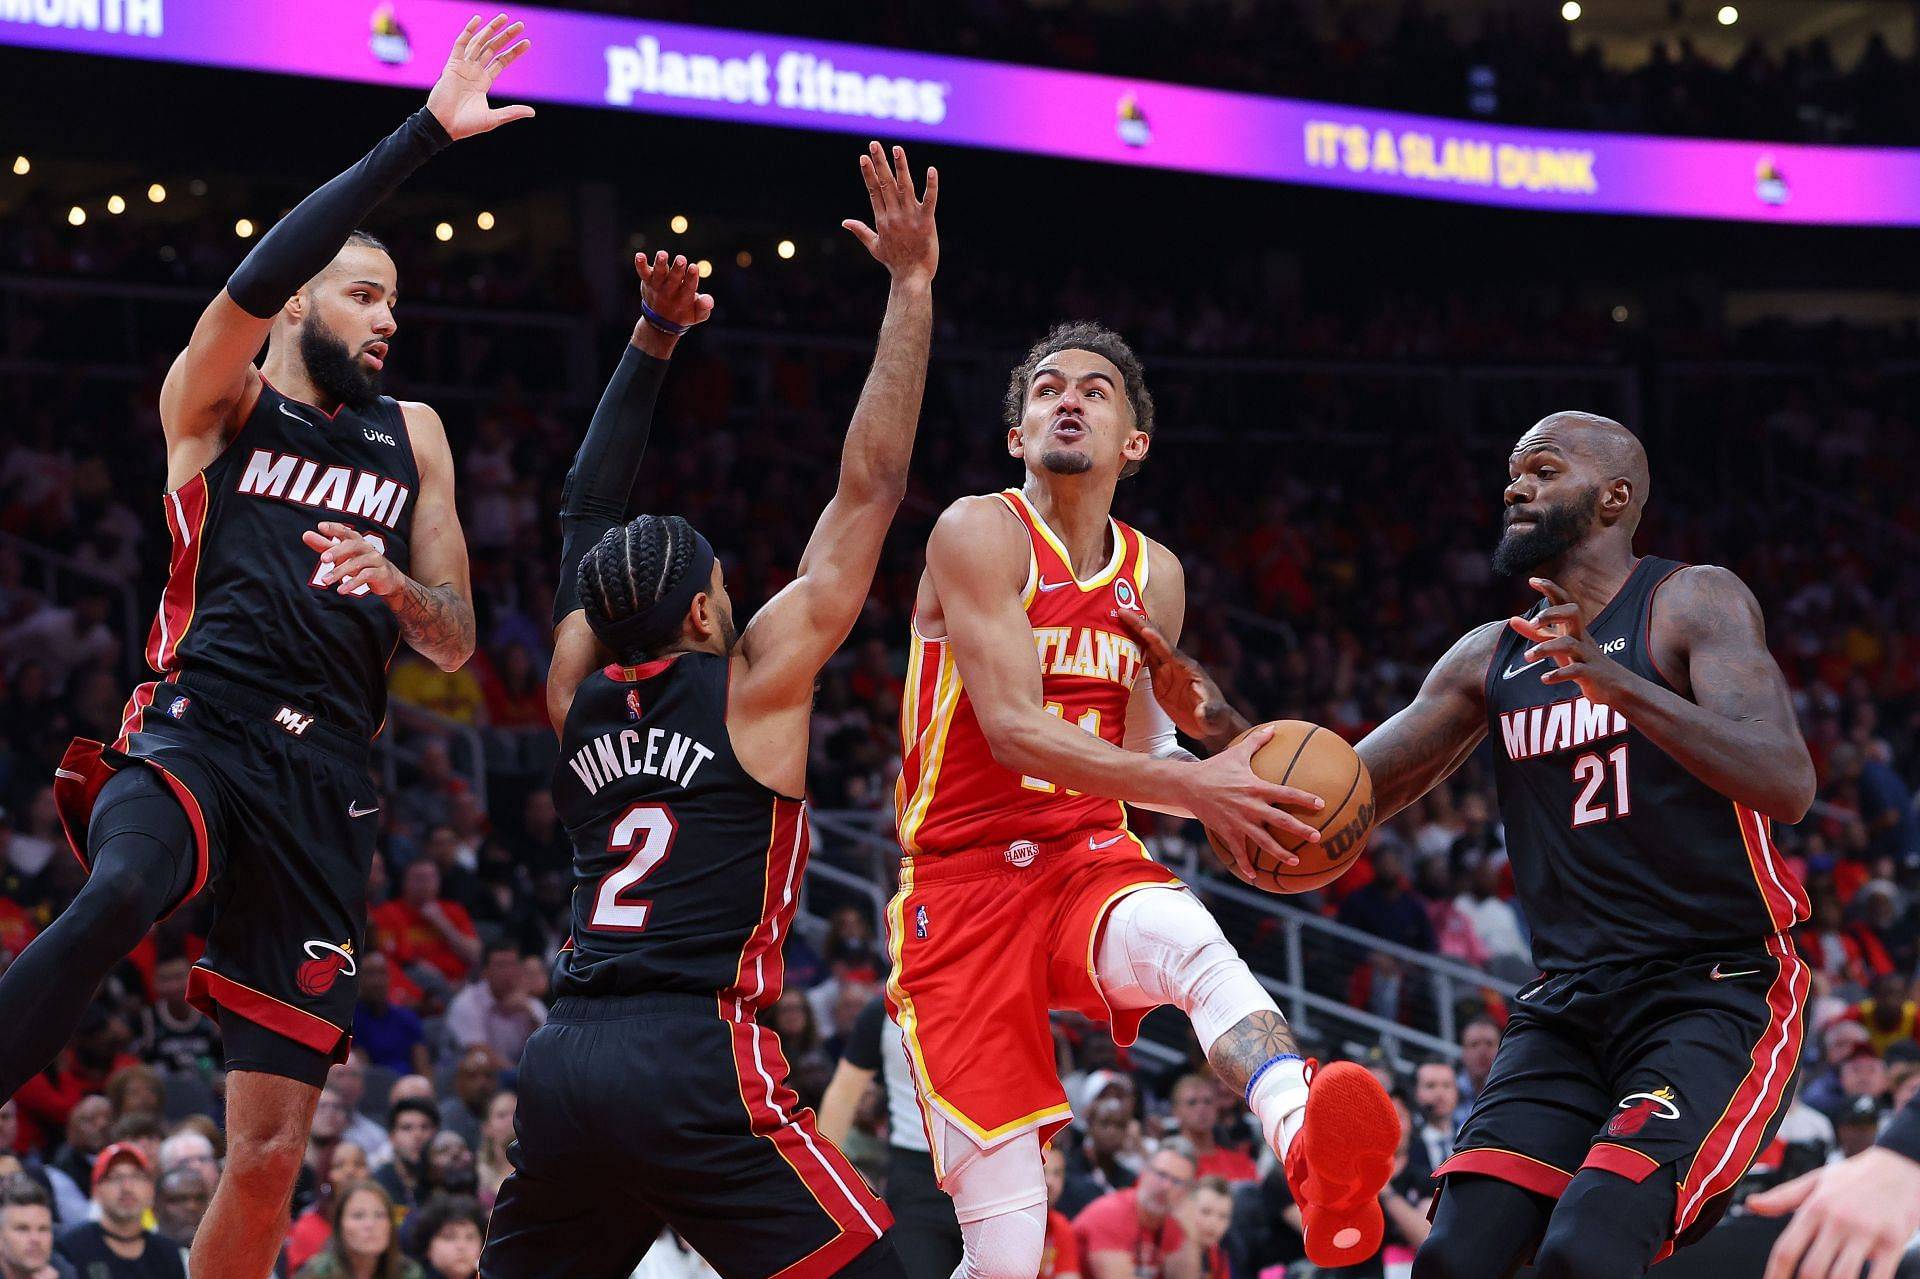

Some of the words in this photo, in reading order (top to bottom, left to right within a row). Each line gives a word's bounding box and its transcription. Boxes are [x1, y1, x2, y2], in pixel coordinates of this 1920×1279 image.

[604, 35, 771, 105] planet
[775, 50, 947, 125] fitness
[1304, 120, 1369, 171] IT'S
[1371, 128, 1400, 174] A
[1400, 131, 1492, 186] SLAM
[1497, 142, 1597, 195] DUNK
[236, 449, 410, 530] MIAMI
[1032, 626, 1142, 691] TLANT
[1599, 637, 1626, 655] KG
[568, 727, 715, 796] VINCENT
[1572, 744, 1631, 828] 21
[588, 803, 679, 931] 2
[1004, 844, 1039, 862] HAWKS
